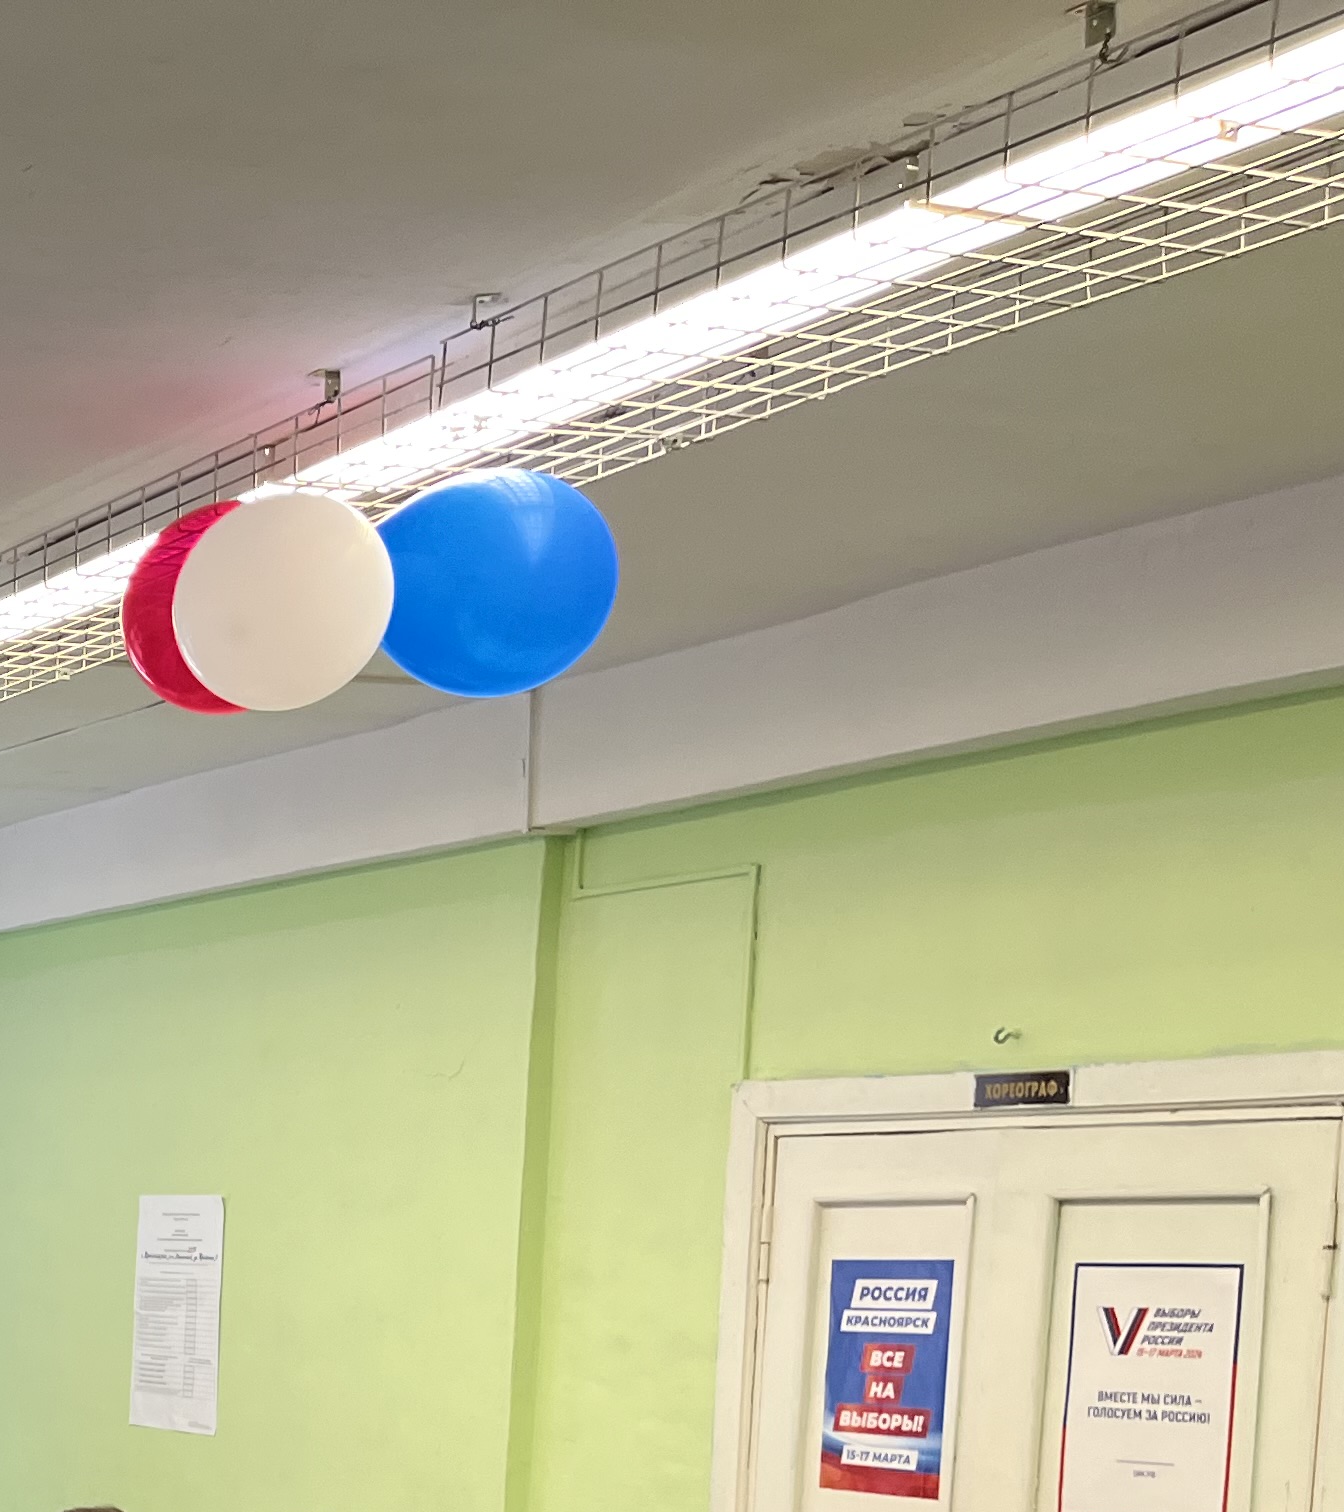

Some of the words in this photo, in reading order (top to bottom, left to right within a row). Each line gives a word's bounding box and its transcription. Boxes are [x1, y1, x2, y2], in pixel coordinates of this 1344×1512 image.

[859, 1286, 929, 1301] РОССИЯ
[1153, 1307, 1202, 1318] ВЫБОРЫ
[845, 1315, 930, 1329] КРАСНОЯРСК
[1146, 1321, 1214, 1333] ПРЕЗИДЕНТА
[1140, 1334, 1184, 1345] РОССИИ
[869, 1350, 905, 1368] ВСЕ
[868, 1381, 895, 1399] НА
[1097, 1390, 1138, 1404] ВМЕСТЕ
[1140, 1393, 1160, 1405] МЫ
[1163, 1394, 1192, 1406] СИЛА
[839, 1410, 925, 1433] ВЫБОРЫ!
[1087, 1406, 1142, 1421] ГОЛОСУЕМ
[1145, 1410, 1158, 1421] ЗА
[1161, 1411, 1211, 1425] РОССИЮ!
[845, 1449, 870, 1461] 15-17
[872, 1451, 911, 1465] МАРТА
